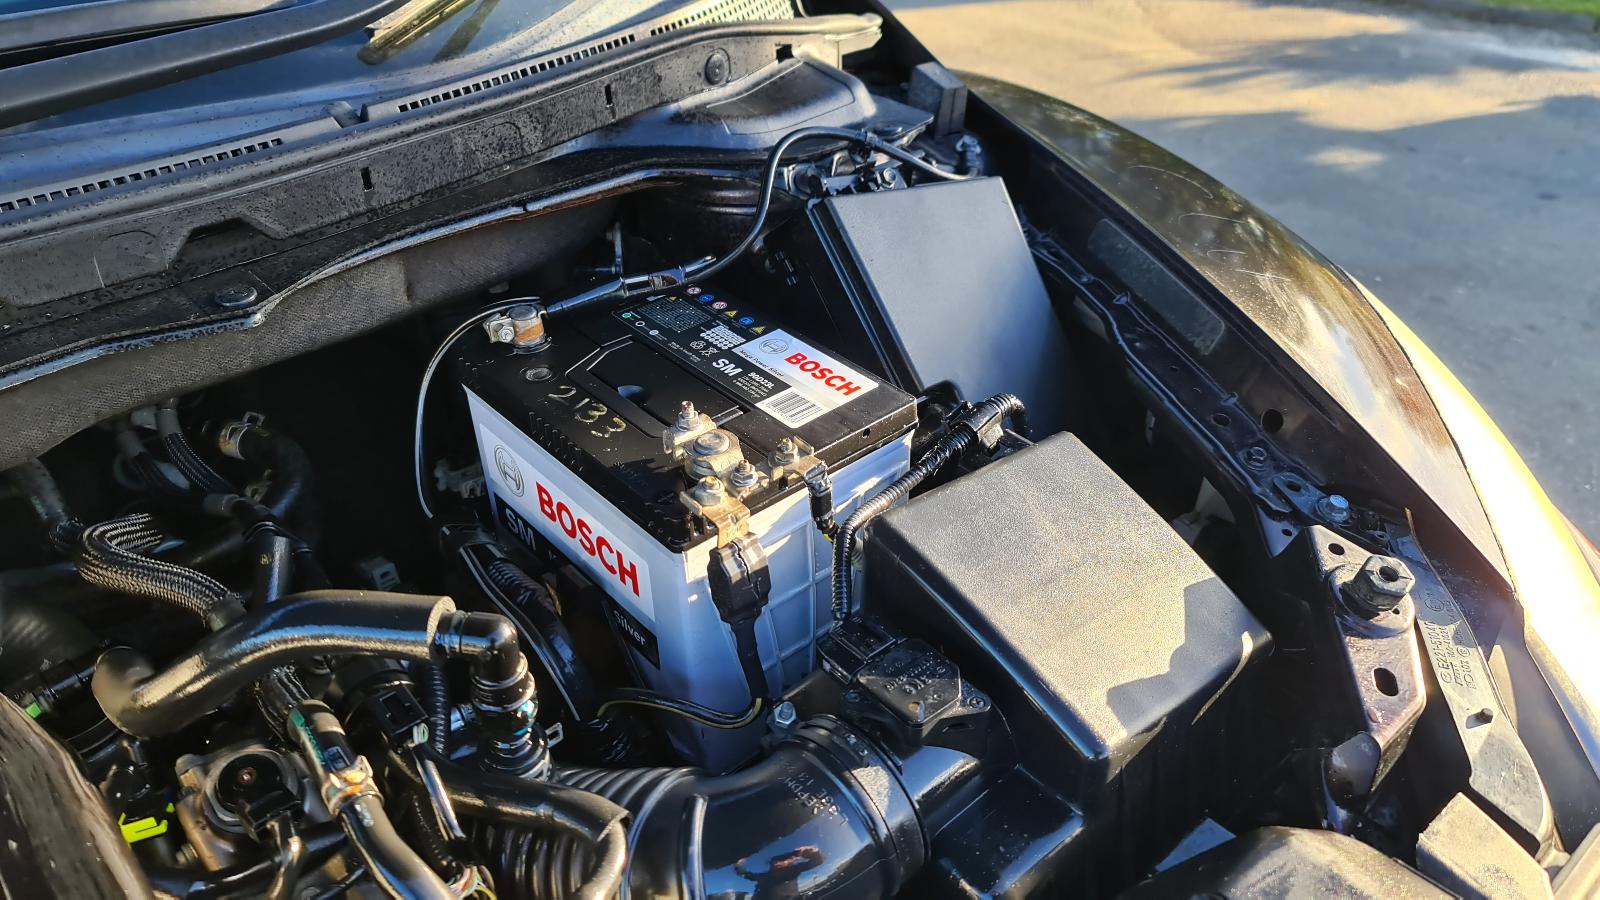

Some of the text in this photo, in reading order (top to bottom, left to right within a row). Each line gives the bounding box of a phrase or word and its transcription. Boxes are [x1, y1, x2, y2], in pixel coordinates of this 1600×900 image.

[712, 358, 744, 377] SM
[784, 351, 863, 397] BOSCH
[504, 508, 537, 551] SM
[535, 481, 640, 598] BOSCH
[614, 609, 647, 646] Silver
